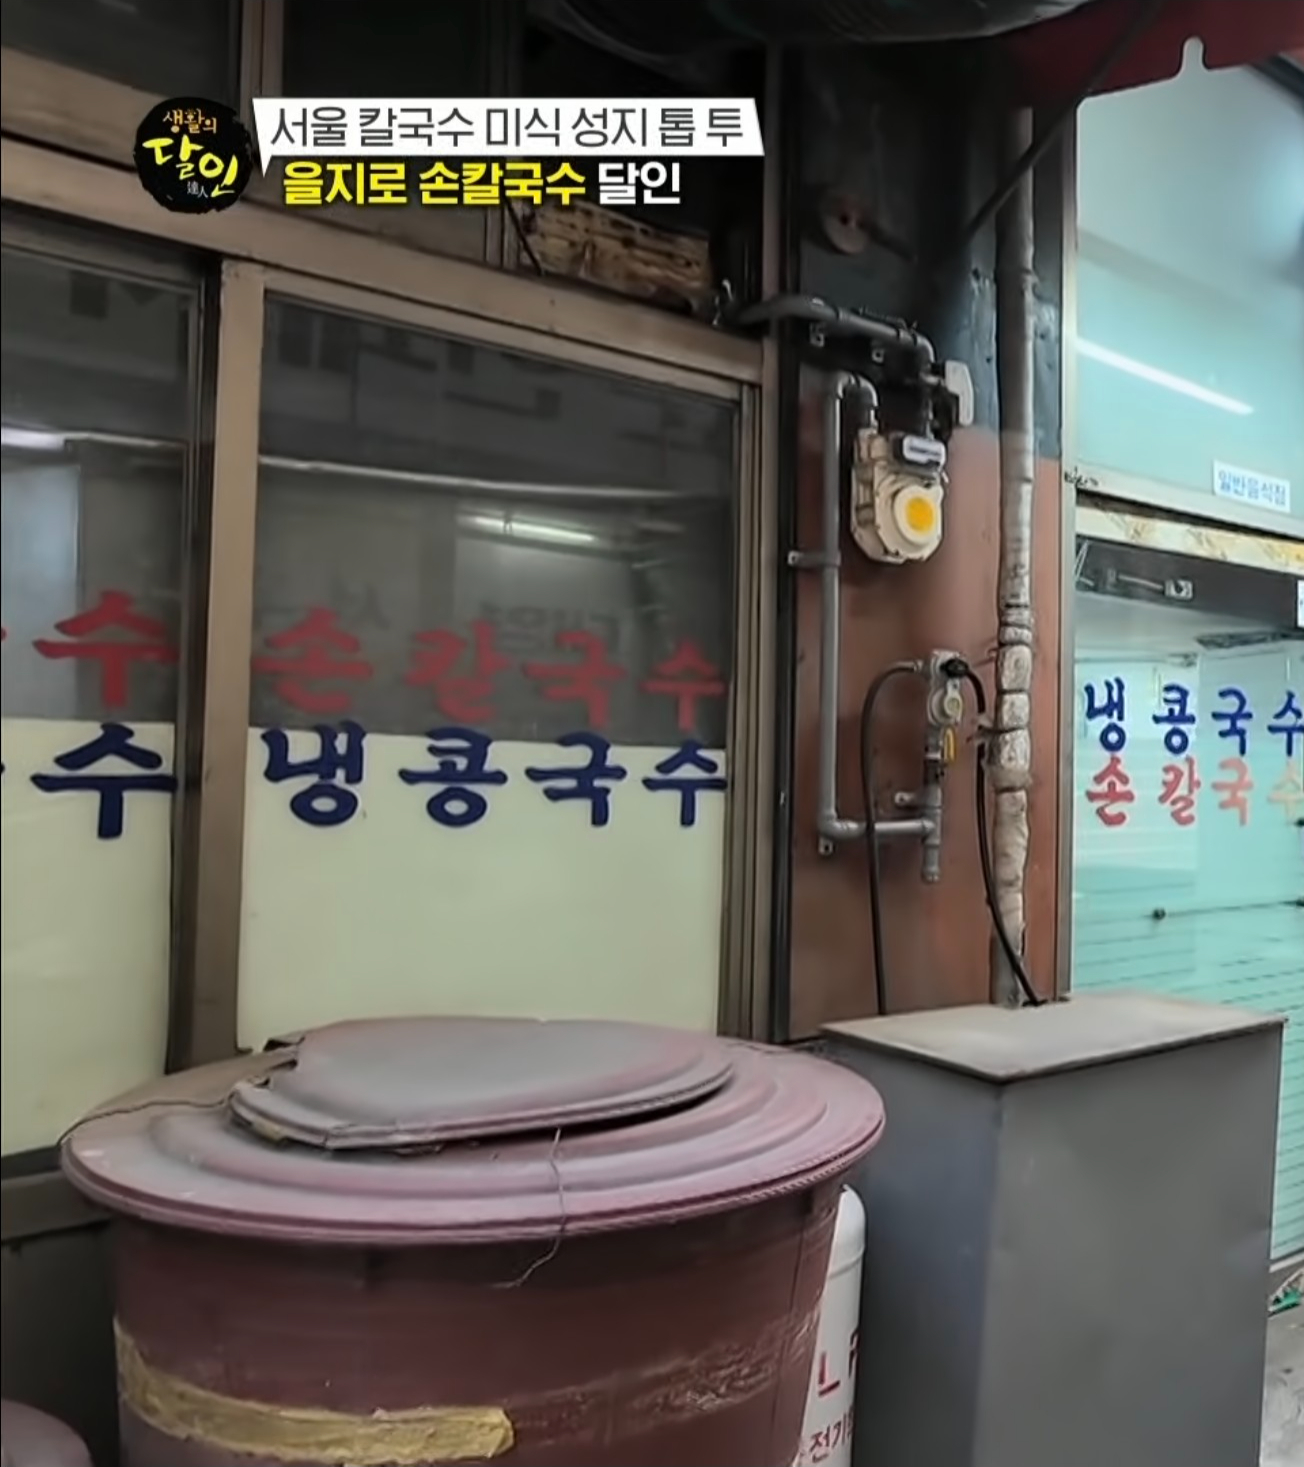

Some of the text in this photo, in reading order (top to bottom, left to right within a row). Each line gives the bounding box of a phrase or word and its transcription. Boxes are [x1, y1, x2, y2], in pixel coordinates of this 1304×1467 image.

[0, 589, 180, 709] 수
[252, 607, 728, 732] 손칼국수
[0, 721, 179, 840] 수
[260, 720, 729, 828] 냉콩국수
[1085, 755, 1304, 826] 손칼국수
